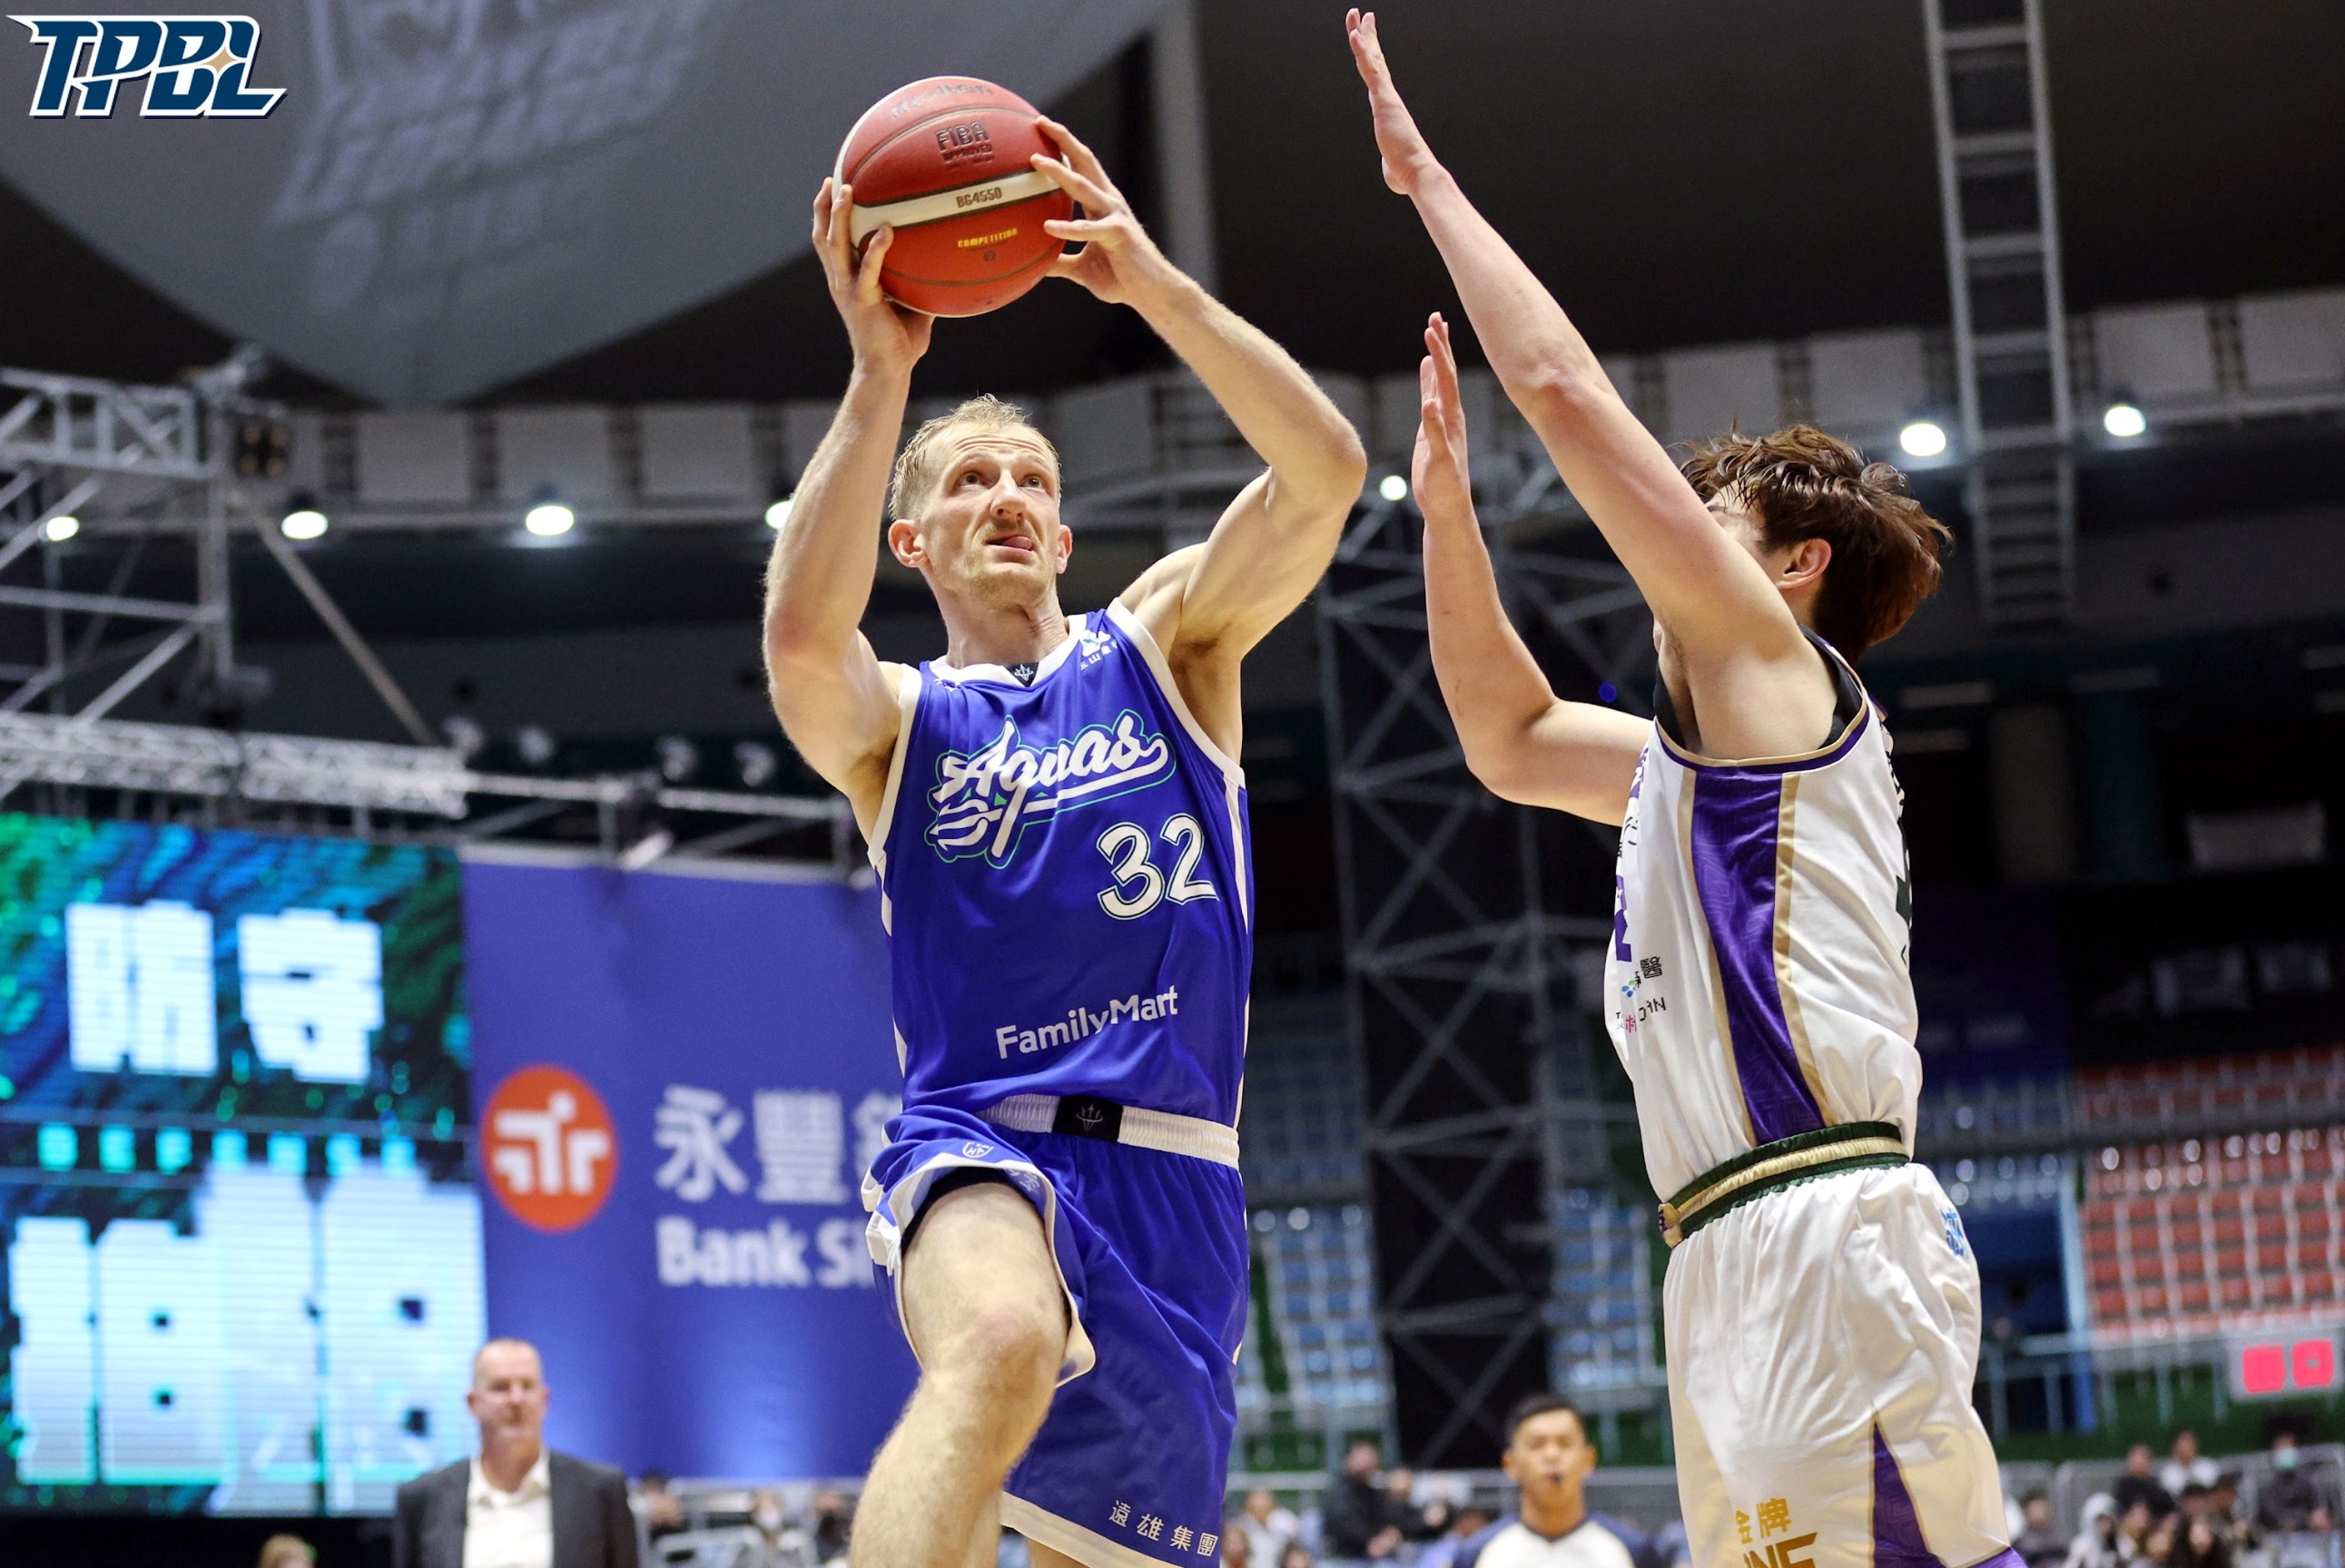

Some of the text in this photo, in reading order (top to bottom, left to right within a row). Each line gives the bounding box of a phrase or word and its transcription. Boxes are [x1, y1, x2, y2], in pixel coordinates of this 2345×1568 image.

[936, 122, 990, 152] FIBA
[956, 187, 1003, 208] BG4550
[932, 715, 1169, 858] Aquas
[1096, 813, 1219, 920] 32
[996, 985, 1177, 1060] FamilyMart
[655, 1215, 810, 1287] Bank
[1108, 1500, 1218, 1557] 遠雄集團
